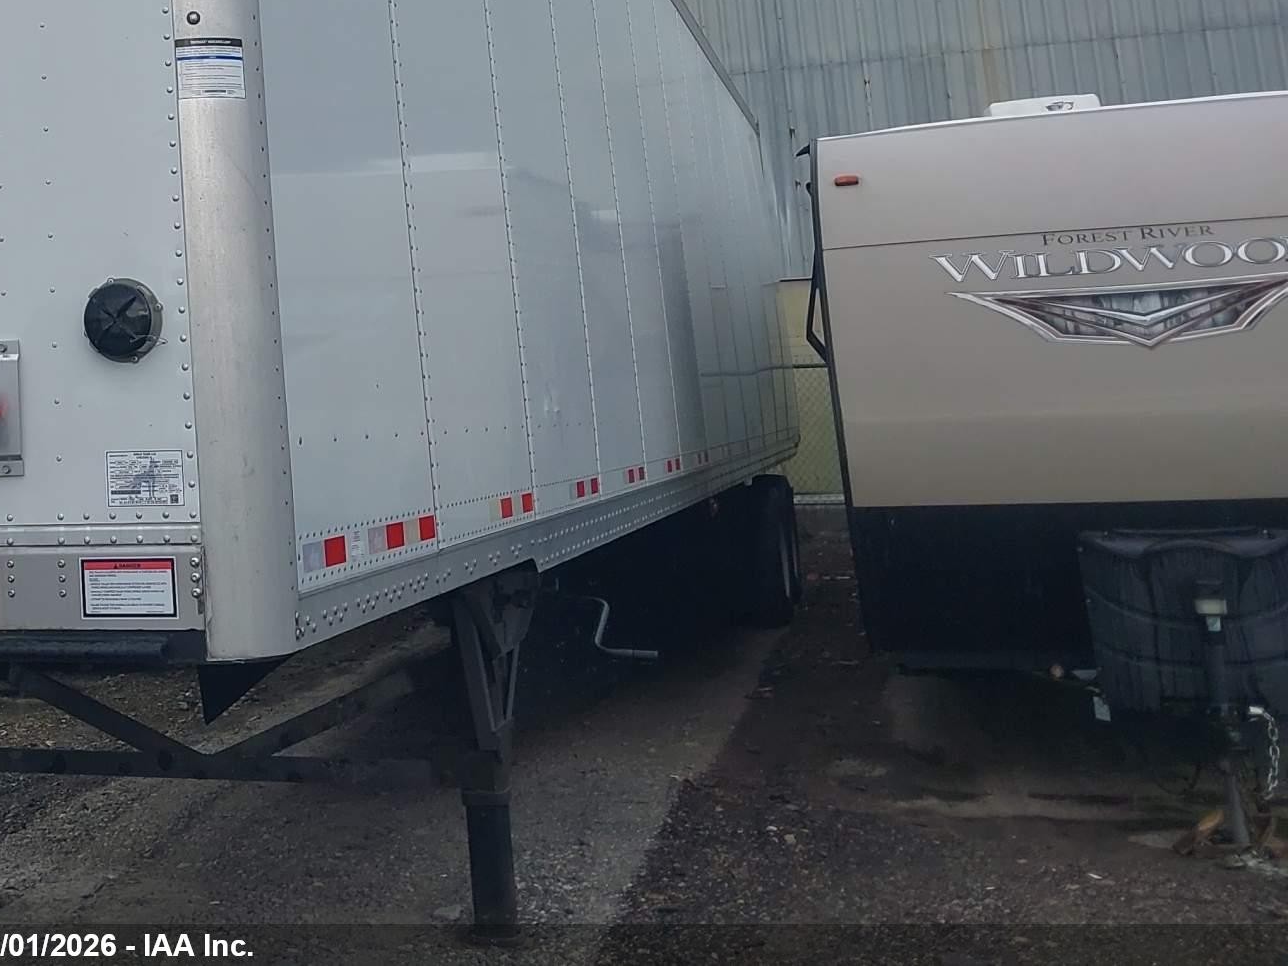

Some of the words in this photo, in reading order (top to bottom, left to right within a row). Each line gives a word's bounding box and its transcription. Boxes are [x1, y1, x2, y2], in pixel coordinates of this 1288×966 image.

[1042, 230, 1133, 246] FOREST
[1140, 225, 1215, 240] RIVER
[929, 236, 1288, 283] WILDWOO
